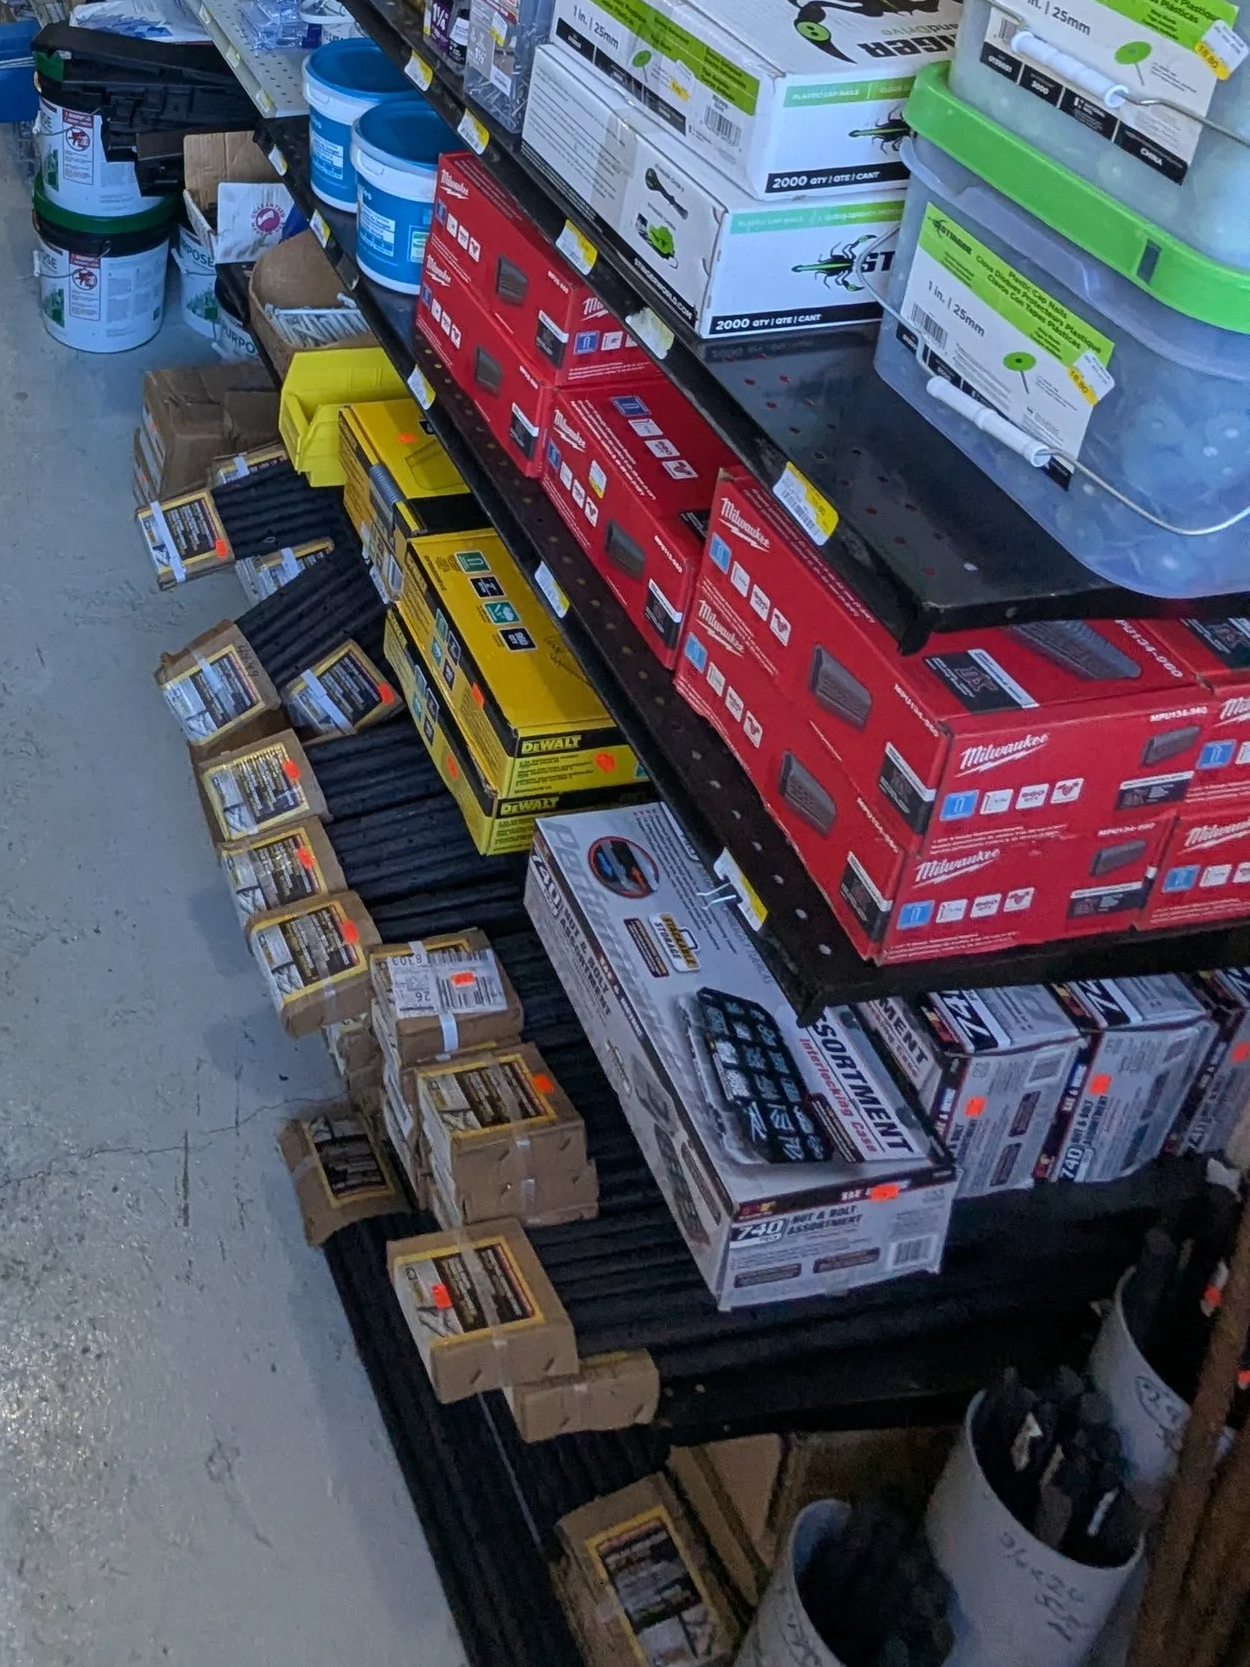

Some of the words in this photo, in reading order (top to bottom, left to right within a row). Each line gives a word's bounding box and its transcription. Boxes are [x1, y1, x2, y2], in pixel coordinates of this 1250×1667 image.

[578, 7, 588, 25] in.
[593, 21, 619, 50] 25mm
[1053, 6, 1091, 36] 25mm
[772, 176, 808, 190] 2000
[810, 175, 828, 185] QTY
[855, 170, 881, 182] CANT
[928, 280, 933, 292] 1
[934, 285, 946, 304] in.
[953, 303, 985, 338] 25mm
[1032, 286, 1047, 305] Cap
[715, 318, 750, 331] 2000
[752, 317, 770, 327] QTY
[798, 313, 822, 322] CANT
[721, 496, 770, 548] Milwaukee
[699, 599, 745, 651] Milwaukee
[958, 735, 1049, 770] Milwaukee
[915, 848, 1000, 882] Milwaukee
[654, 921, 681, 959] STORAGE
[800, 1037, 854, 1118] Interlocking
[738, 1220, 784, 1237] 740
